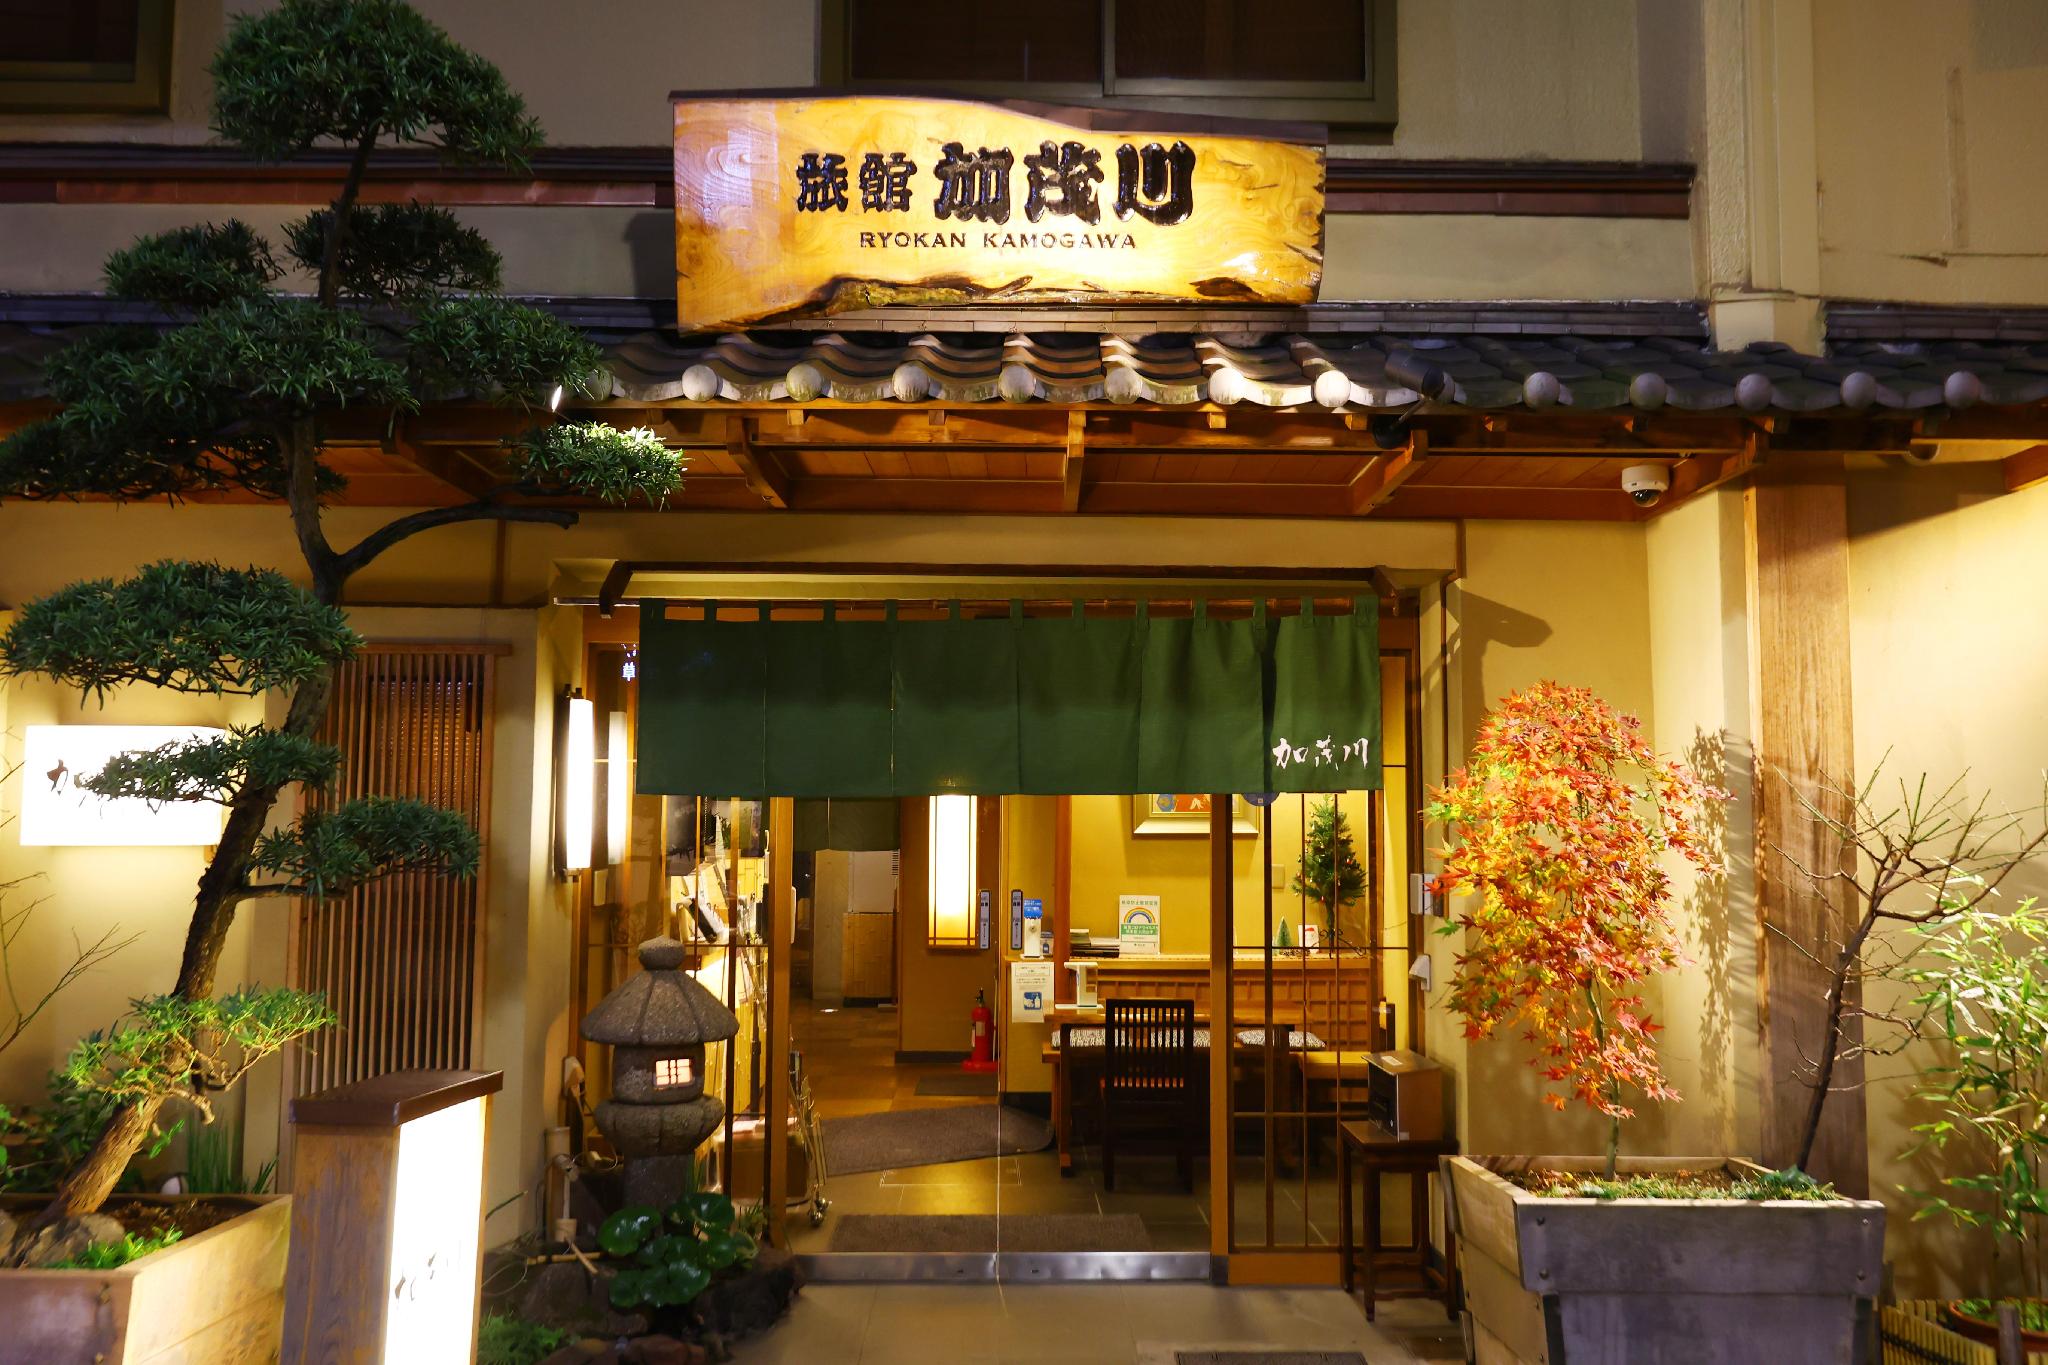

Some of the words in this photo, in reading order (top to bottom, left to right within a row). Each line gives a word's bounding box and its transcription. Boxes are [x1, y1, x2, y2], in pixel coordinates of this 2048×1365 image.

[859, 231, 967, 249] RYOKAN
[983, 231, 1137, 249] KAMOGAWA
[1272, 734, 1369, 772] 加茂川
